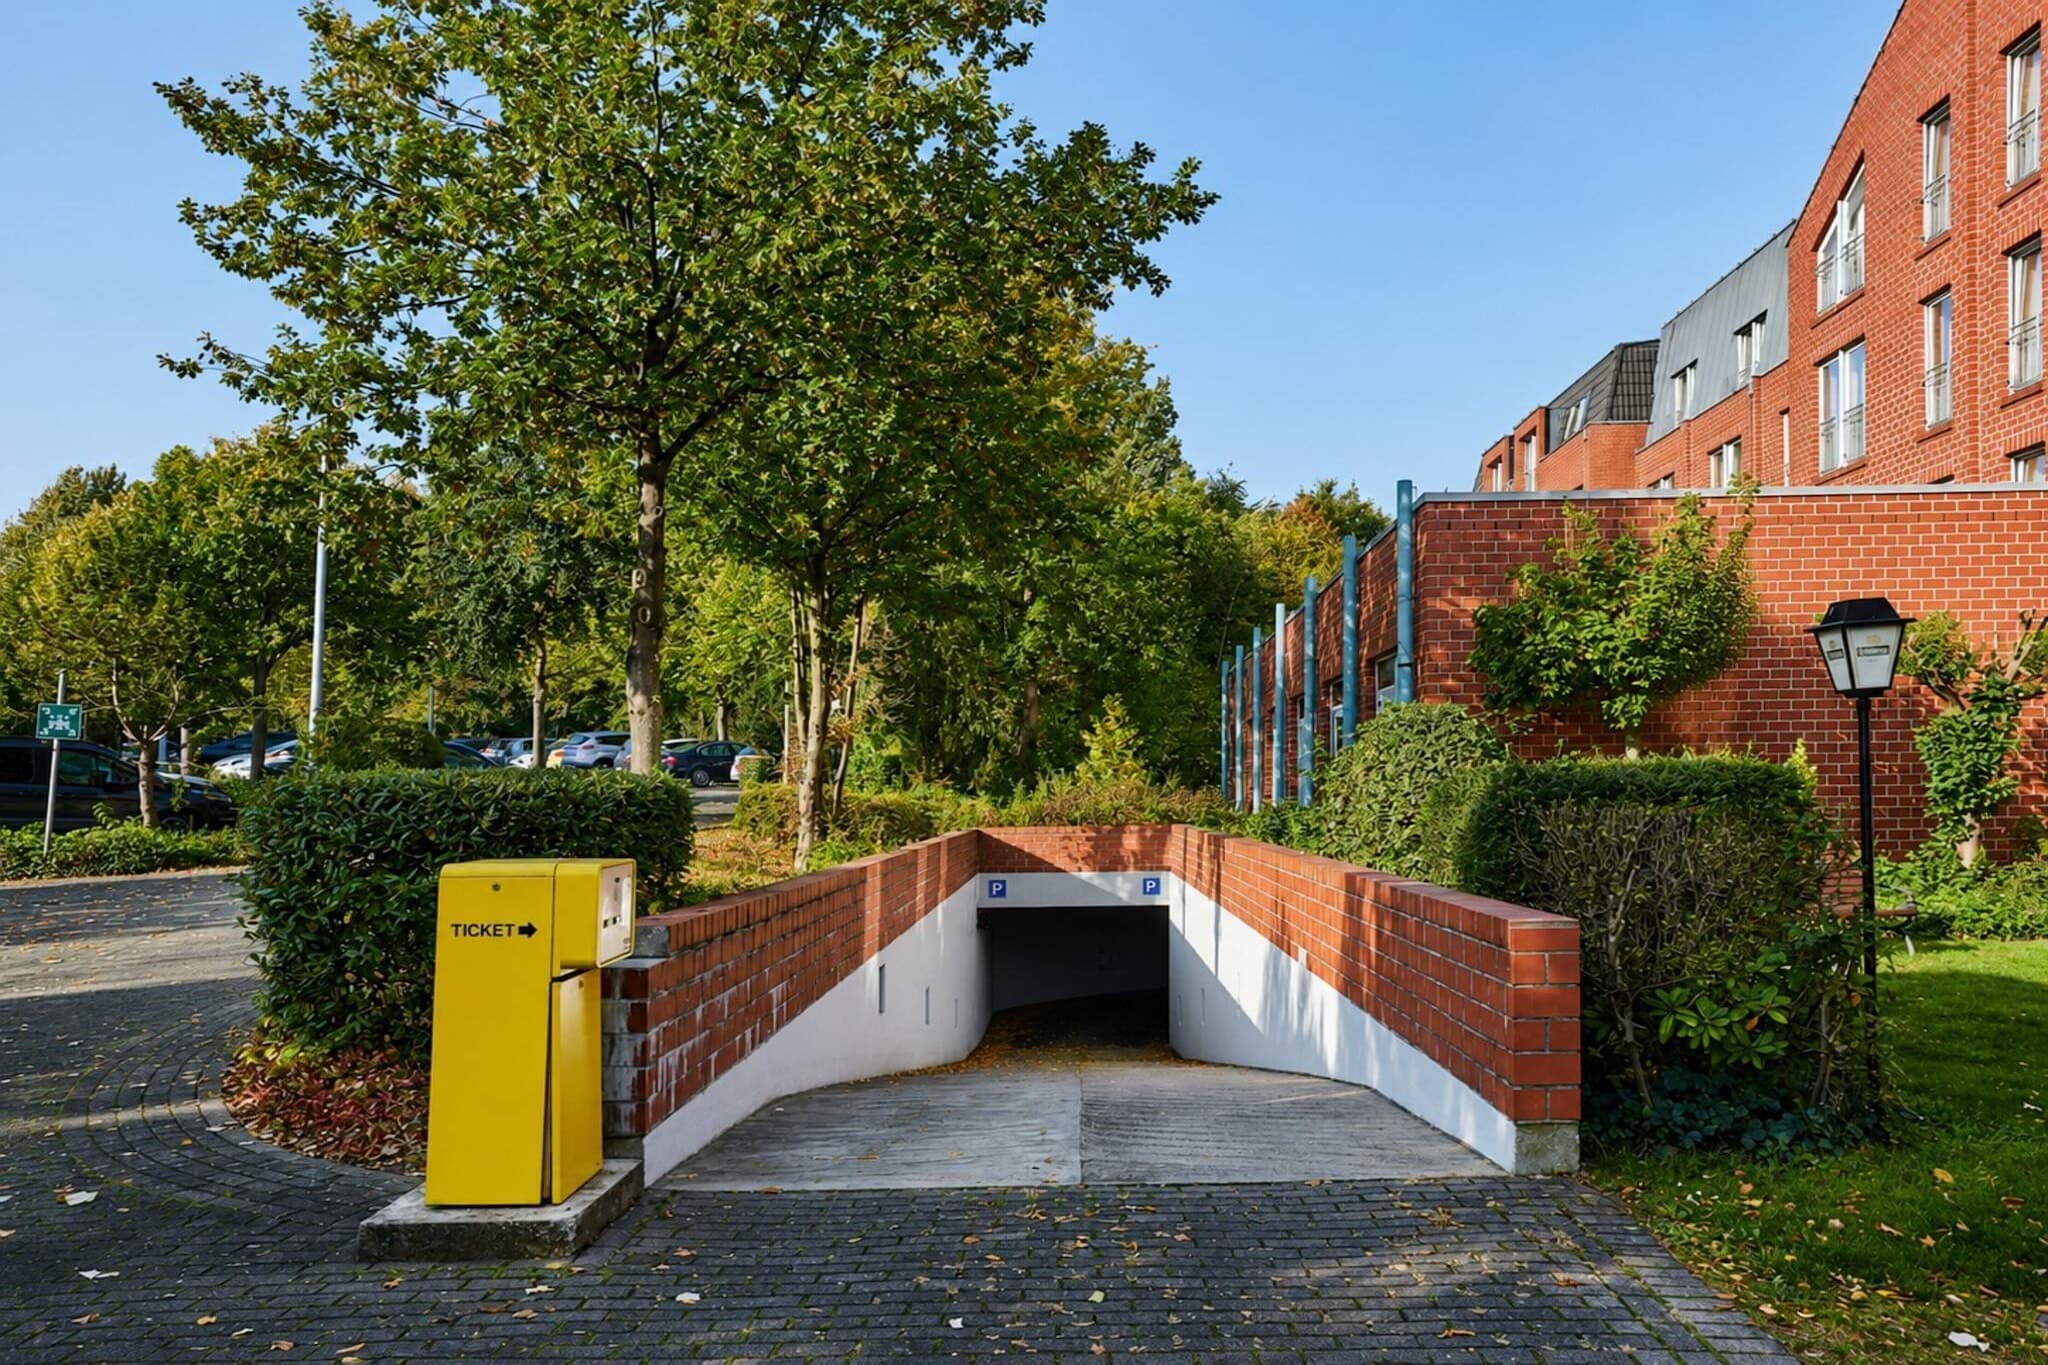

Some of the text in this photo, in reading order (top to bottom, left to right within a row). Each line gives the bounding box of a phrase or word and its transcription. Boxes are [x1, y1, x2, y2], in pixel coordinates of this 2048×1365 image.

[992, 882, 1003, 895] P
[1146, 880, 1157, 893] P
[450, 923, 516, 937] TICKET
